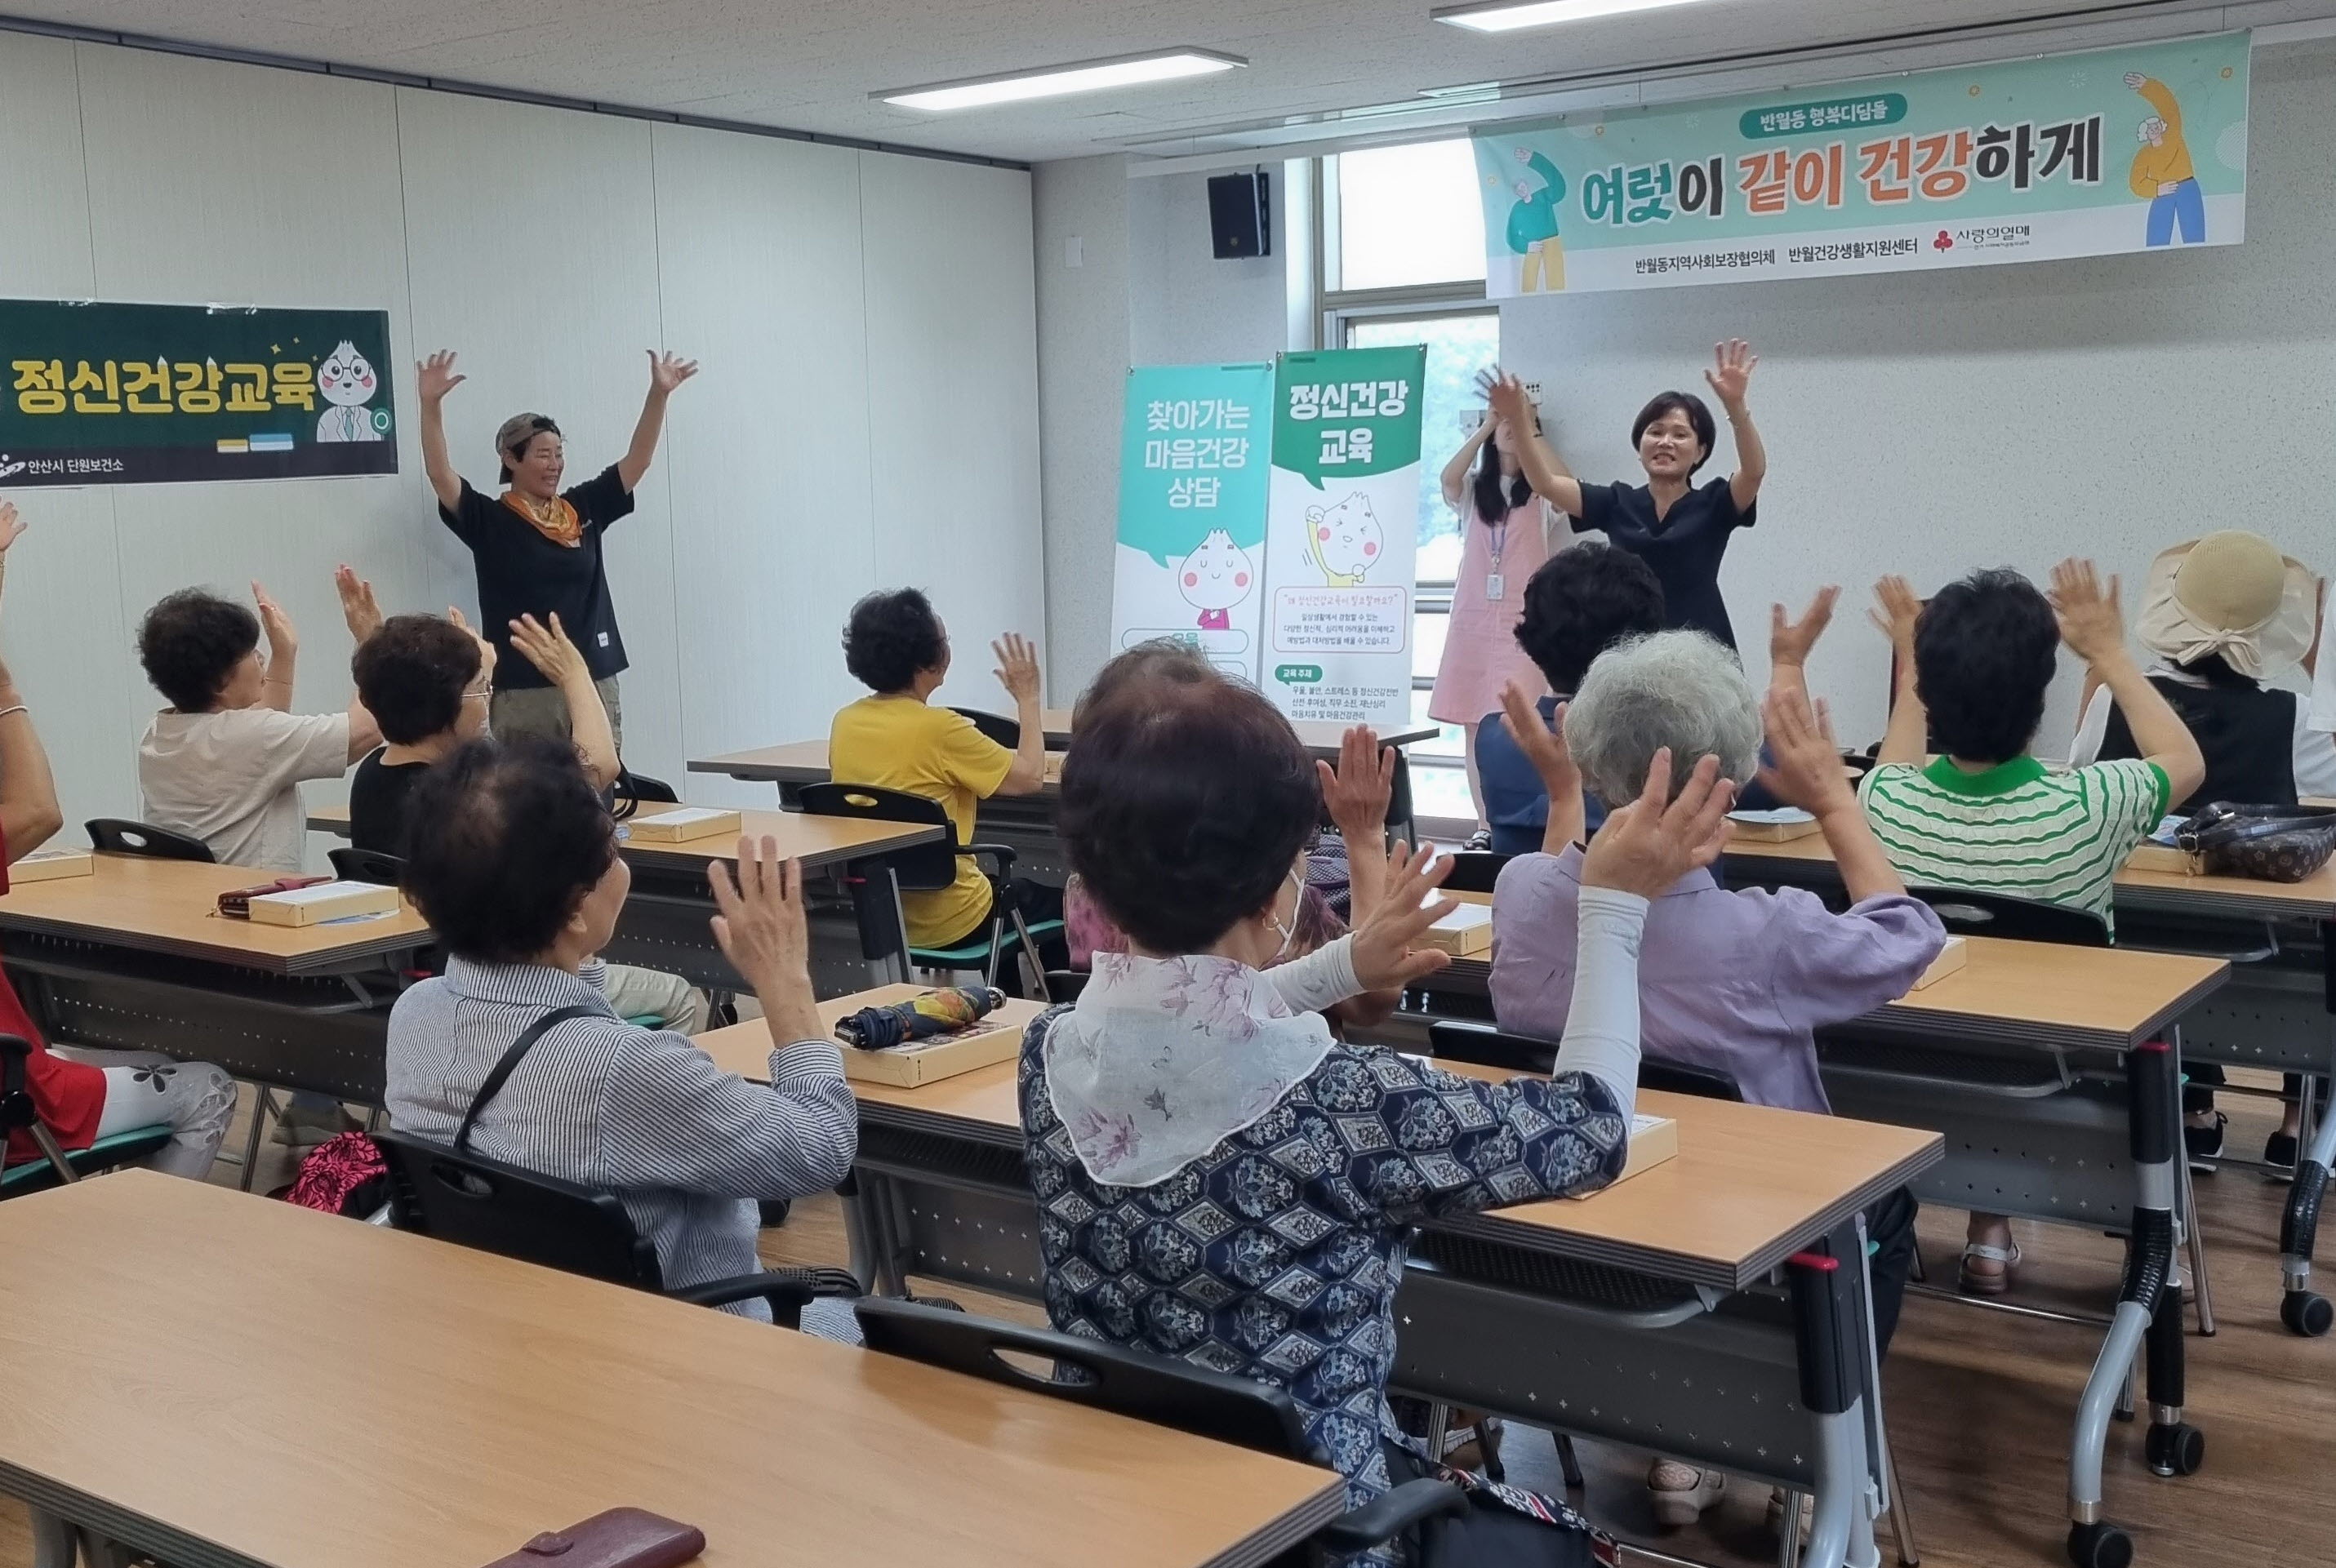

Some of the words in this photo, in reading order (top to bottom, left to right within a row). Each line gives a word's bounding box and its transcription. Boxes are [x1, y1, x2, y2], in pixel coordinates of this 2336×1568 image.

[1760, 109, 1806, 132] 반월동
[1809, 100, 1889, 127] 행복디딤돌
[1582, 157, 1724, 225] 여럿이
[1738, 144, 1842, 213] 같이
[1858, 116, 2101, 202] 건강하게
[1956, 224, 2030, 244] 사랑의열매
[1635, 248, 1776, 275] 반월동지역사회보장협의체
[1788, 238, 1919, 263] 반월건강생활지원센터
[11, 357, 316, 414] 정신건강교육
[1288, 379, 1410, 420] 정신건강
[1146, 398, 1251, 433] 찾아가는
[1144, 437, 1250, 470] 마음건강
[1318, 426, 1373, 464] 교육
[28, 458, 65, 474] 안산시
[66, 457, 125, 473] 단원보건소
[1168, 476, 1221, 509] 상담
[1282, 669, 1297, 678] 교육
[1297, 669, 1312, 678] 주제
[1324, 686, 1350, 695] 스트레스
